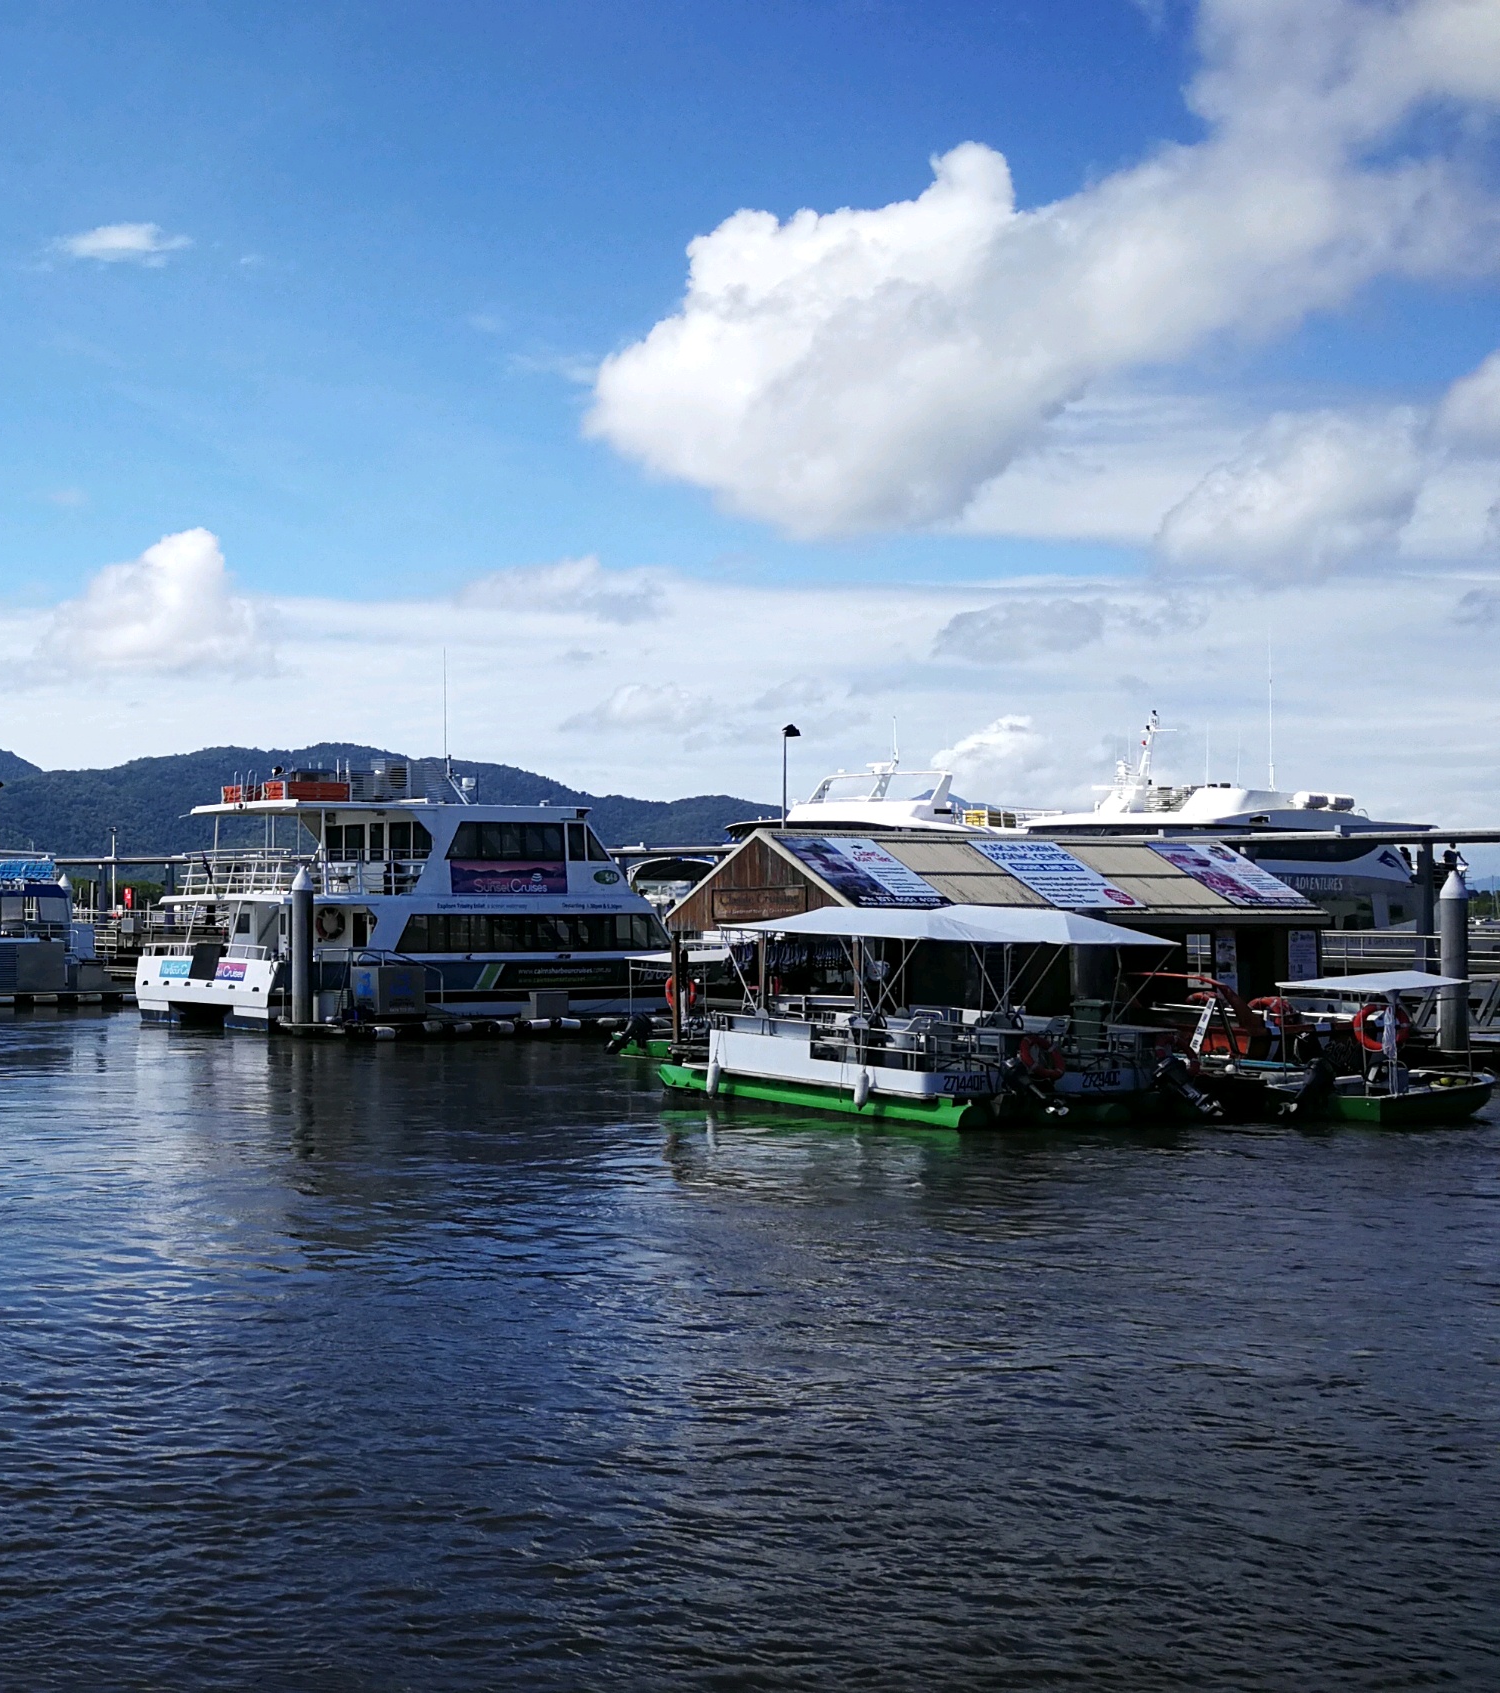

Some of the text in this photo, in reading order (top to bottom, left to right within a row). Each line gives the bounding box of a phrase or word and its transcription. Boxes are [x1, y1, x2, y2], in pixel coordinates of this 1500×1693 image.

[980, 844, 1060, 852] MARLIN MARINA
[987, 853, 1034, 861] BOOKING
[474, 879, 548, 892] Sunset Cruises
[1296, 876, 1343, 890] ADVENTURES
[223, 966, 244, 978] Cruises
